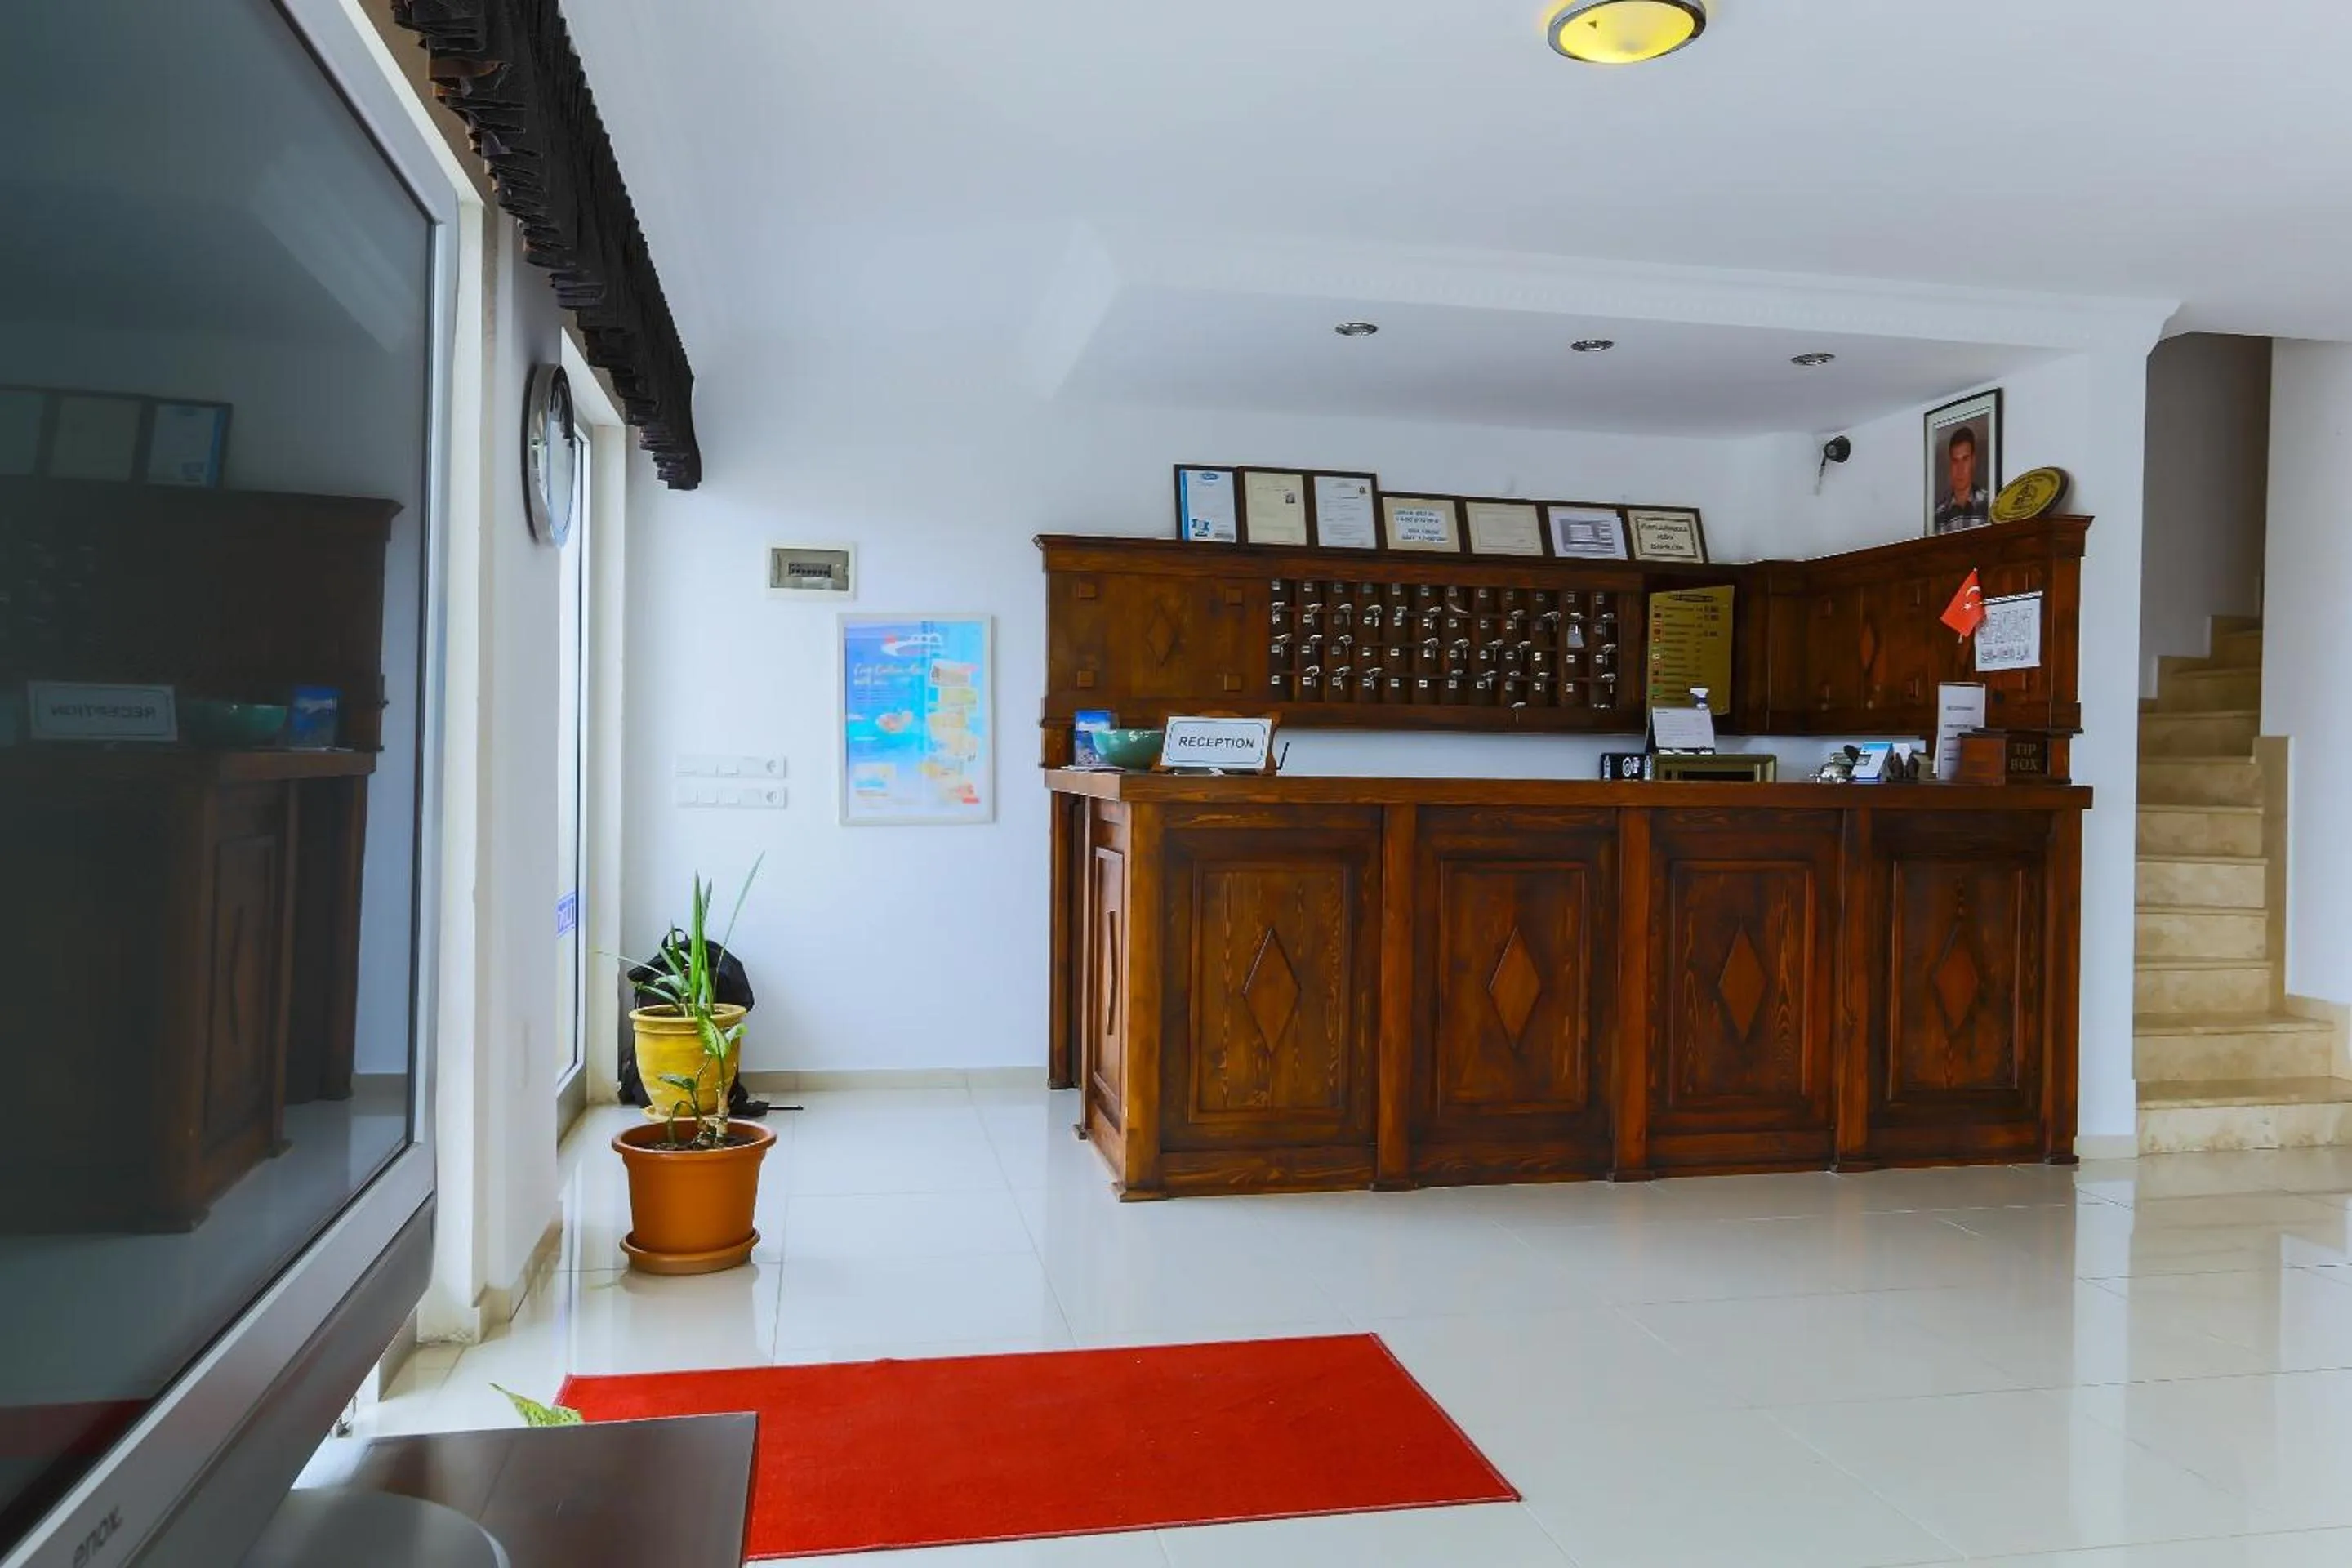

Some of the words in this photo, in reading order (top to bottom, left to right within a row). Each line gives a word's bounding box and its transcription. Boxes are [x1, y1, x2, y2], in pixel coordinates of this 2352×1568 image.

[1178, 736, 1255, 749] RECEPTION
[2014, 742, 2037, 755] TIP
[2009, 758, 2040, 772] BOX
